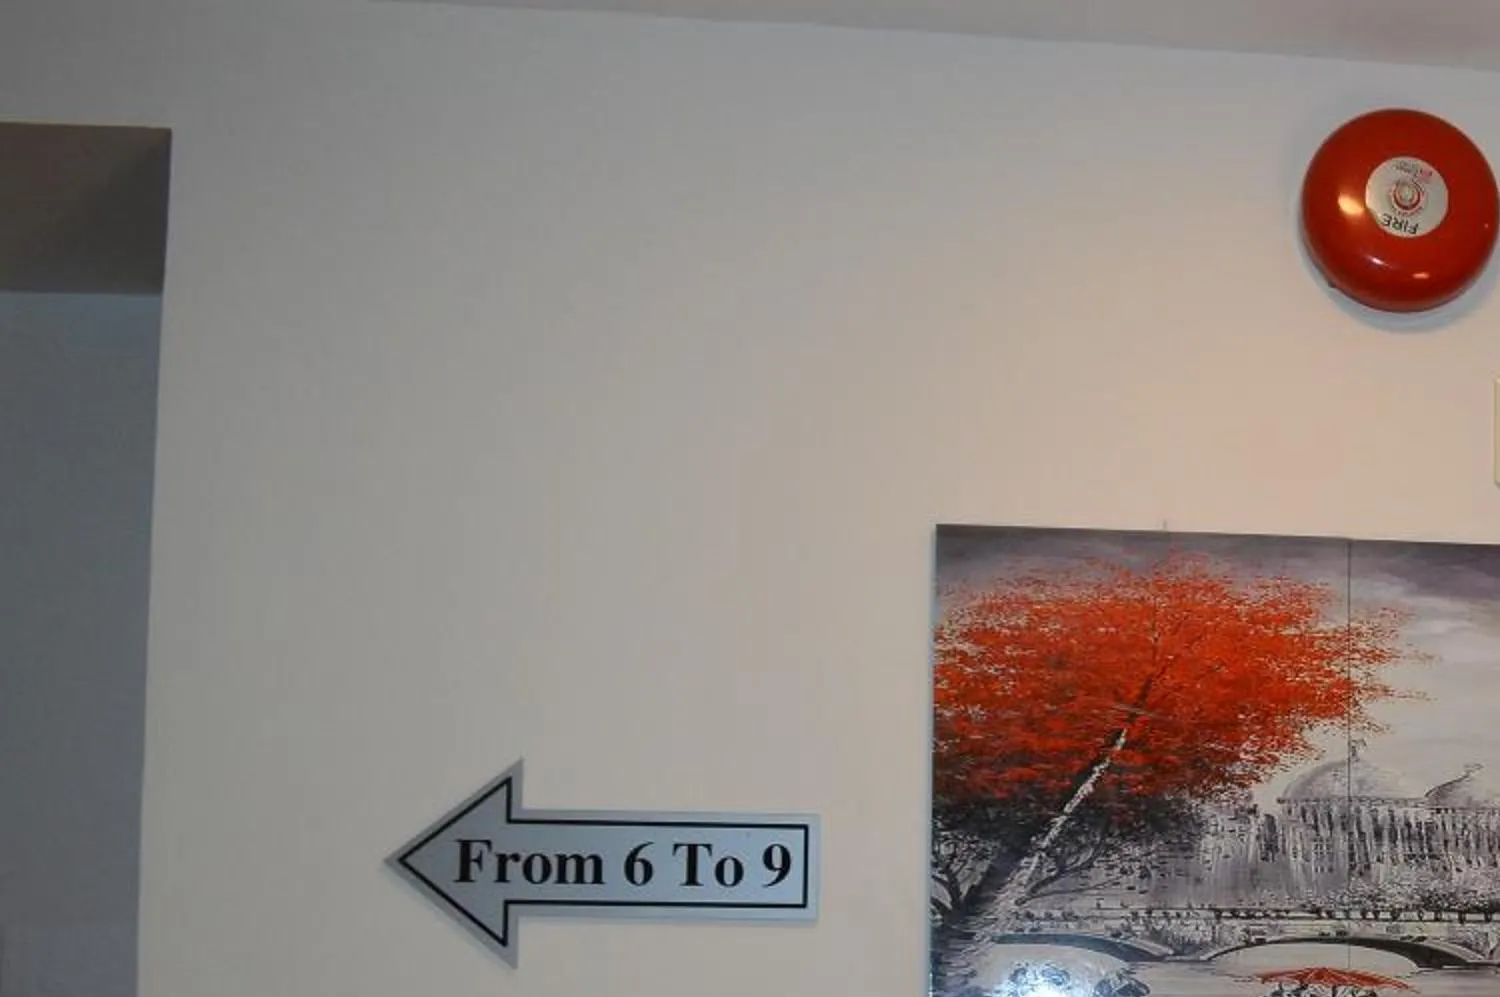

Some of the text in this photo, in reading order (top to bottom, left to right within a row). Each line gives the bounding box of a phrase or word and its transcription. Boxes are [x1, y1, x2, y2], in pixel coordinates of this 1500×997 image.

[1381, 212, 1420, 235] FIRE
[453, 838, 792, 889] From 6 To 9
